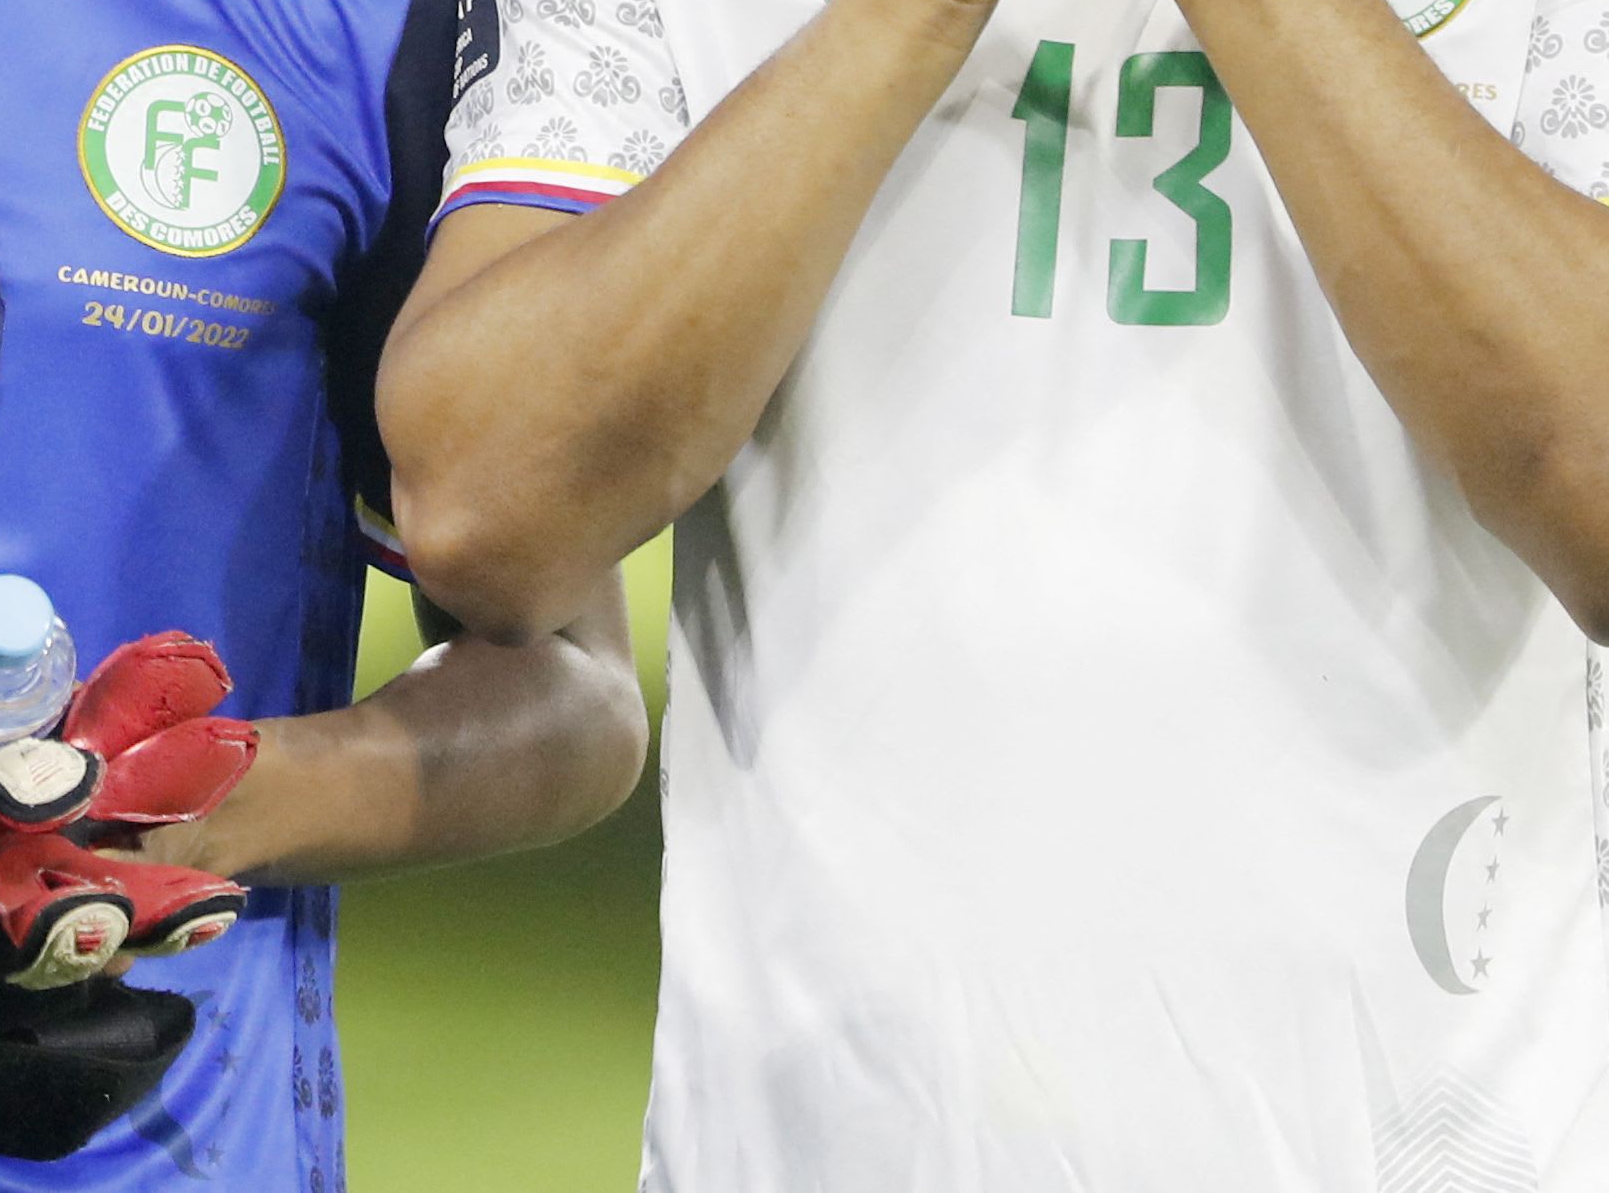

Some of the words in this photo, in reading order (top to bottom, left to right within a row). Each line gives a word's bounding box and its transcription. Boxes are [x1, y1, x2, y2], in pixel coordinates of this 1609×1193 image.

[86, 53, 189, 133] FEDERATION
[193, 55, 222, 81] DE
[221, 69, 281, 166] FOOTBALL
[105, 190, 150, 232] DES
[149, 205, 259, 248] COMORES
[1011, 40, 1233, 326] 13
[80, 300, 252, 349] 24/01/2022
